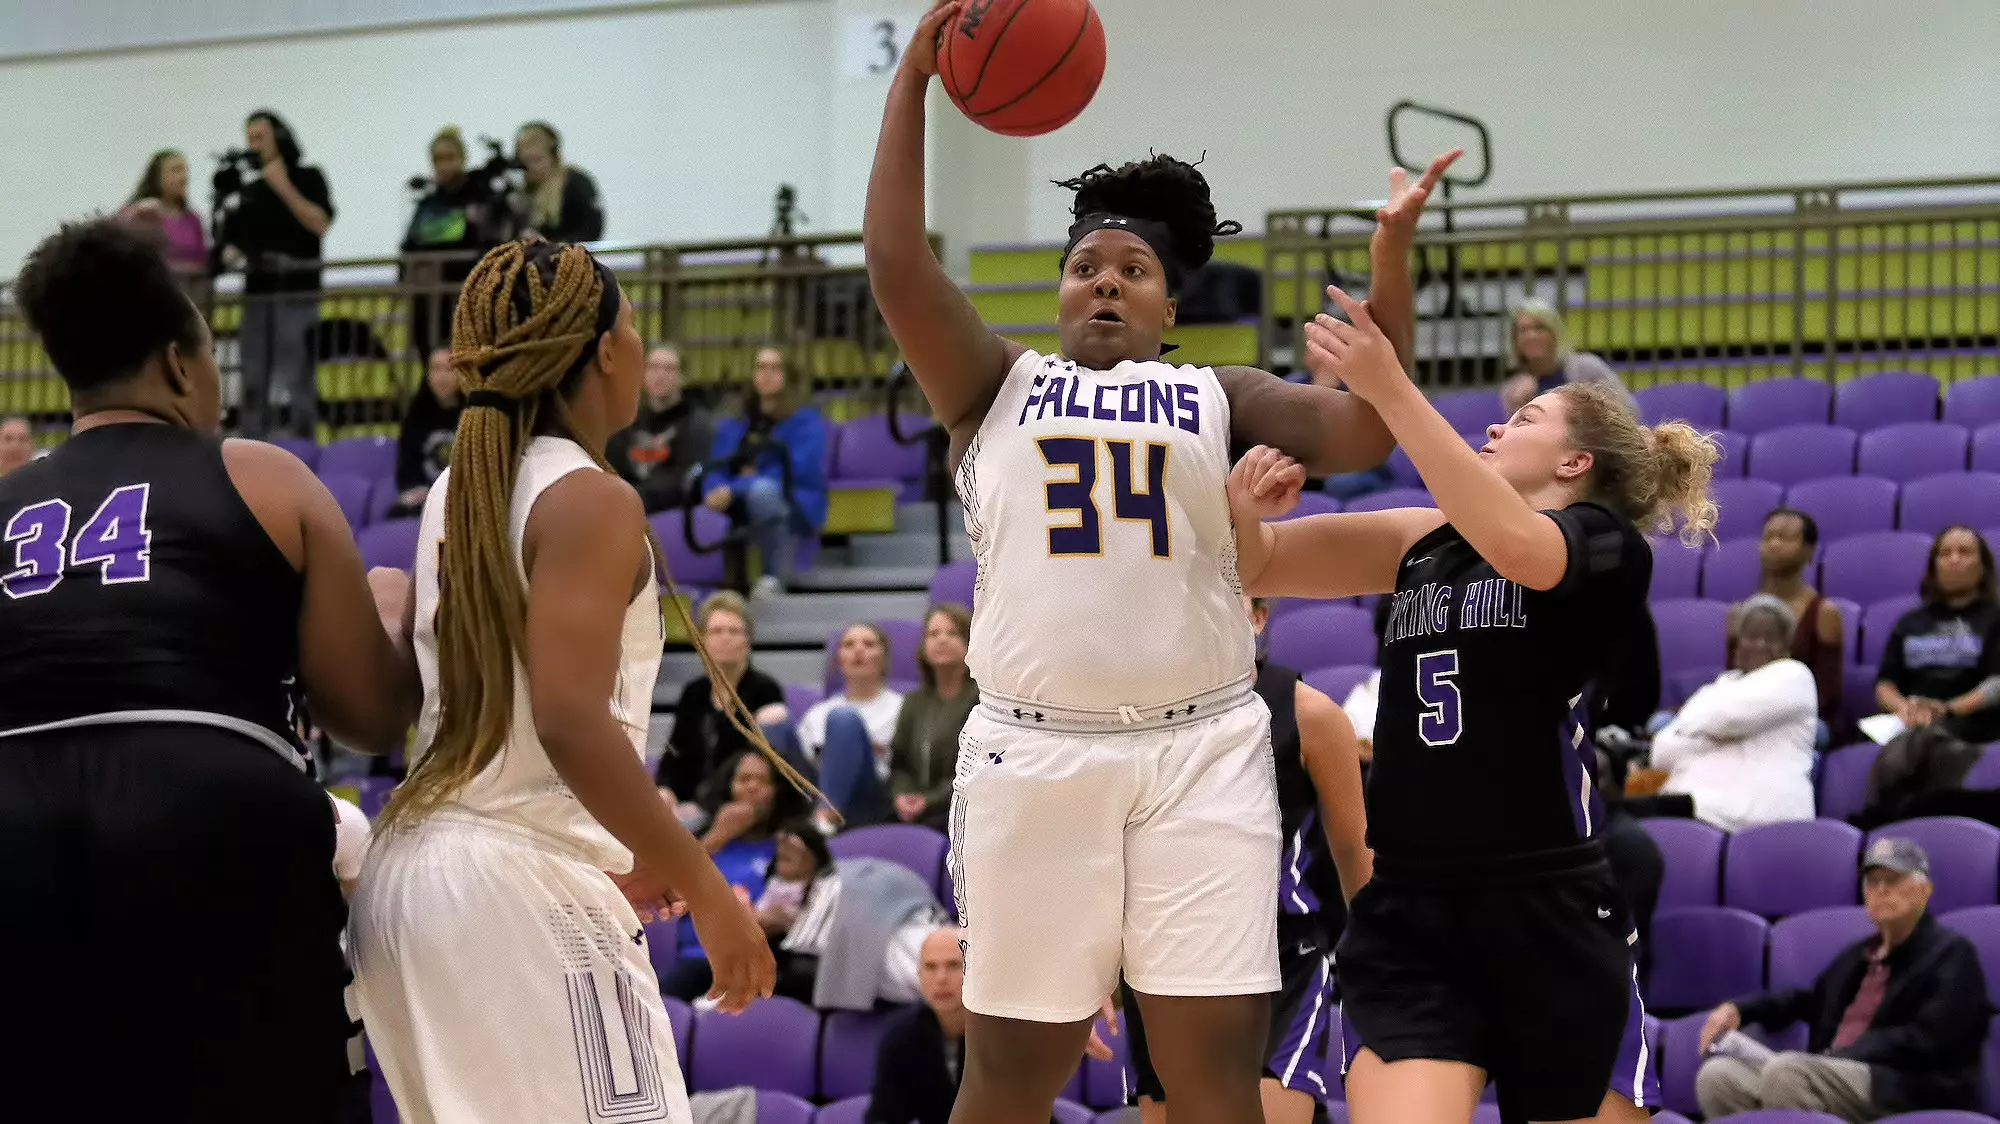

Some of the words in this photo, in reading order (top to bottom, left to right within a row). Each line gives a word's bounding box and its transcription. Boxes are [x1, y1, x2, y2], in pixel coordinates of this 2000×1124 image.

[867, 20, 897, 74] 3
[1018, 374, 1201, 435] FALCONS
[1032, 433, 1174, 561] 34
[0, 482, 153, 600] 34
[1384, 582, 1453, 647] PRING
[1460, 578, 1527, 629] HILL
[1415, 648, 1464, 747] 5
